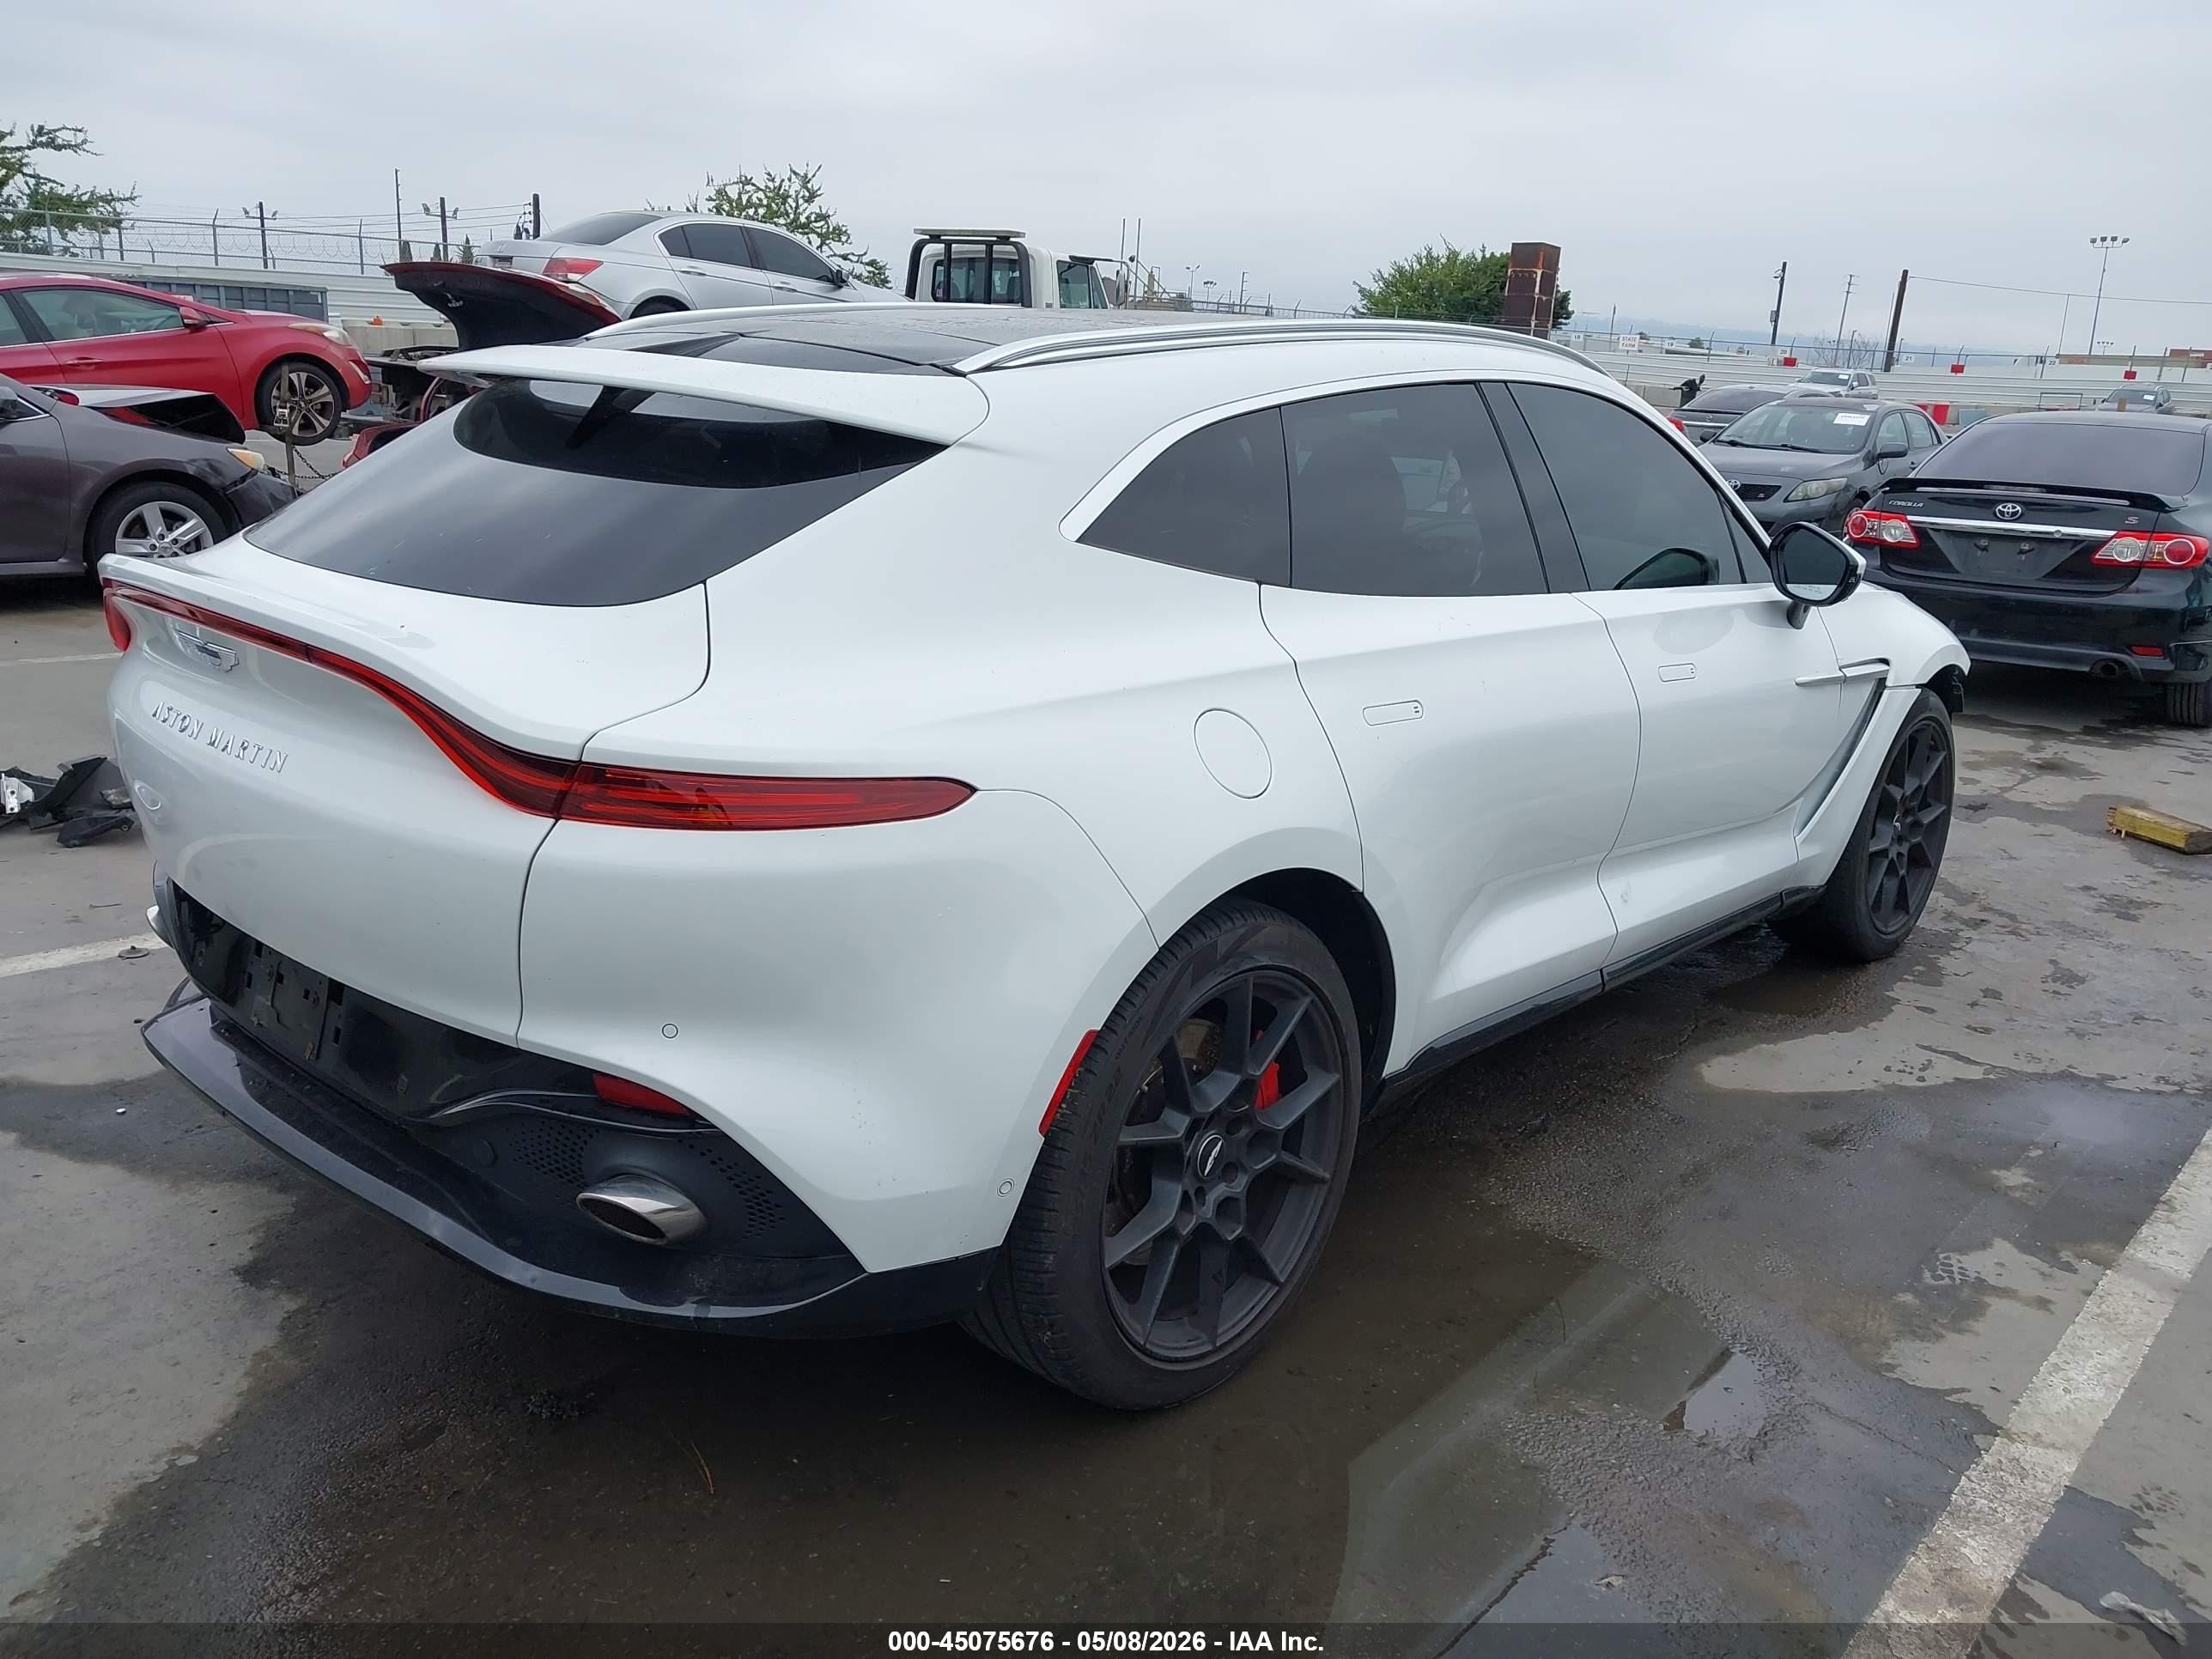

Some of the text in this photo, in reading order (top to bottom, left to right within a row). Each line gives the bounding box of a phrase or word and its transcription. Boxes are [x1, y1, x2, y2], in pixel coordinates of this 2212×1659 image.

[1888, 500, 1924, 508] COROLLA
[2124, 516, 2140, 525] S
[151, 701, 289, 774] ASTON MARTIN
